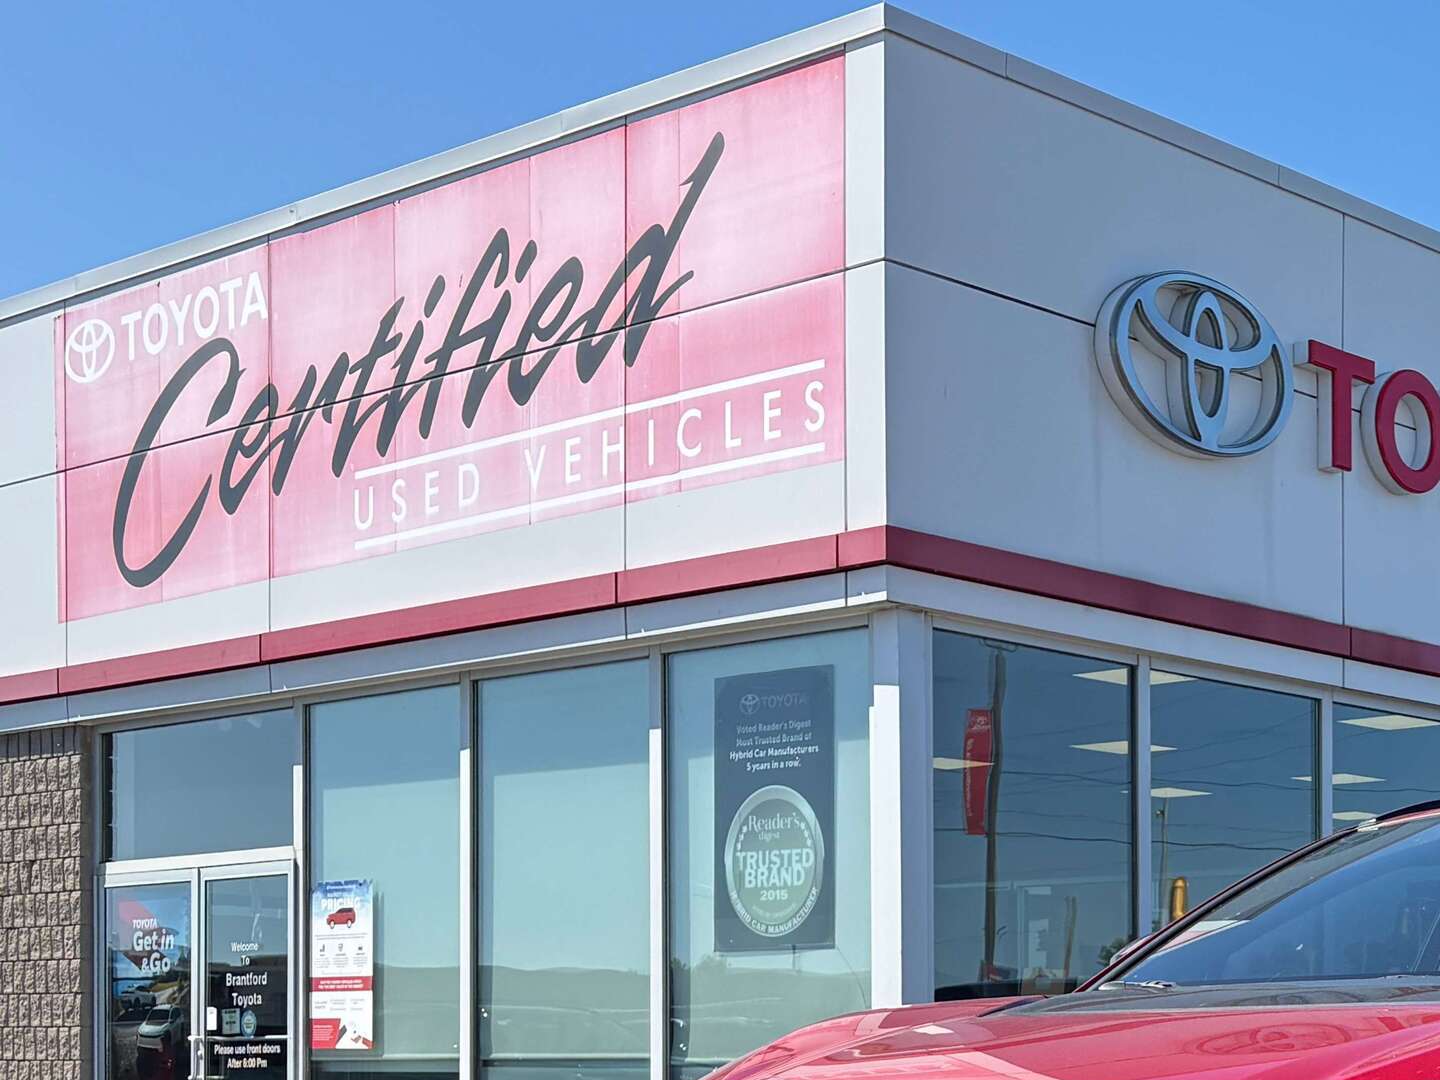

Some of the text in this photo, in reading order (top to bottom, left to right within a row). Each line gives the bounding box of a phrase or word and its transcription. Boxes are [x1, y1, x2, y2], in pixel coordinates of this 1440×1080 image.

[121, 271, 269, 359] TOYOTA
[112, 131, 725, 588] Certified
[353, 378, 826, 530] USED VEHICLES
[761, 692, 808, 709] TOYOTA
[736, 721, 757, 734] Voted
[789, 719, 811, 731] Digest
[754, 734, 781, 746] Trusted
[782, 732, 802, 743] Brand
[803, 731, 812, 741] of
[729, 743, 819, 762] Hybrid Car Manufacturers
[746, 762, 752, 772] 5
[752, 761, 770, 773] years
[772, 759, 778, 769] in
[748, 812, 801, 832] Reader's
[758, 831, 780, 842] digest
[736, 848, 815, 871] TRUSTED
[744, 866, 805, 888] BRAND
[760, 890, 789, 901] 2015
[729, 888, 752, 923] HYBRID
[751, 919, 767, 932] CAR
[768, 886, 819, 934] MANUFACTURER
[132, 918, 158, 929] TOYOTA
[133, 929, 174, 951] Get in
[230, 942, 259, 952] Welcome
[241, 955, 250, 966] To
[225, 972, 268, 987] Brantford
[231, 992, 262, 1009] Toyota
[214, 1043, 281, 1056] Please use front doors
[227, 1058, 242, 1069] After
